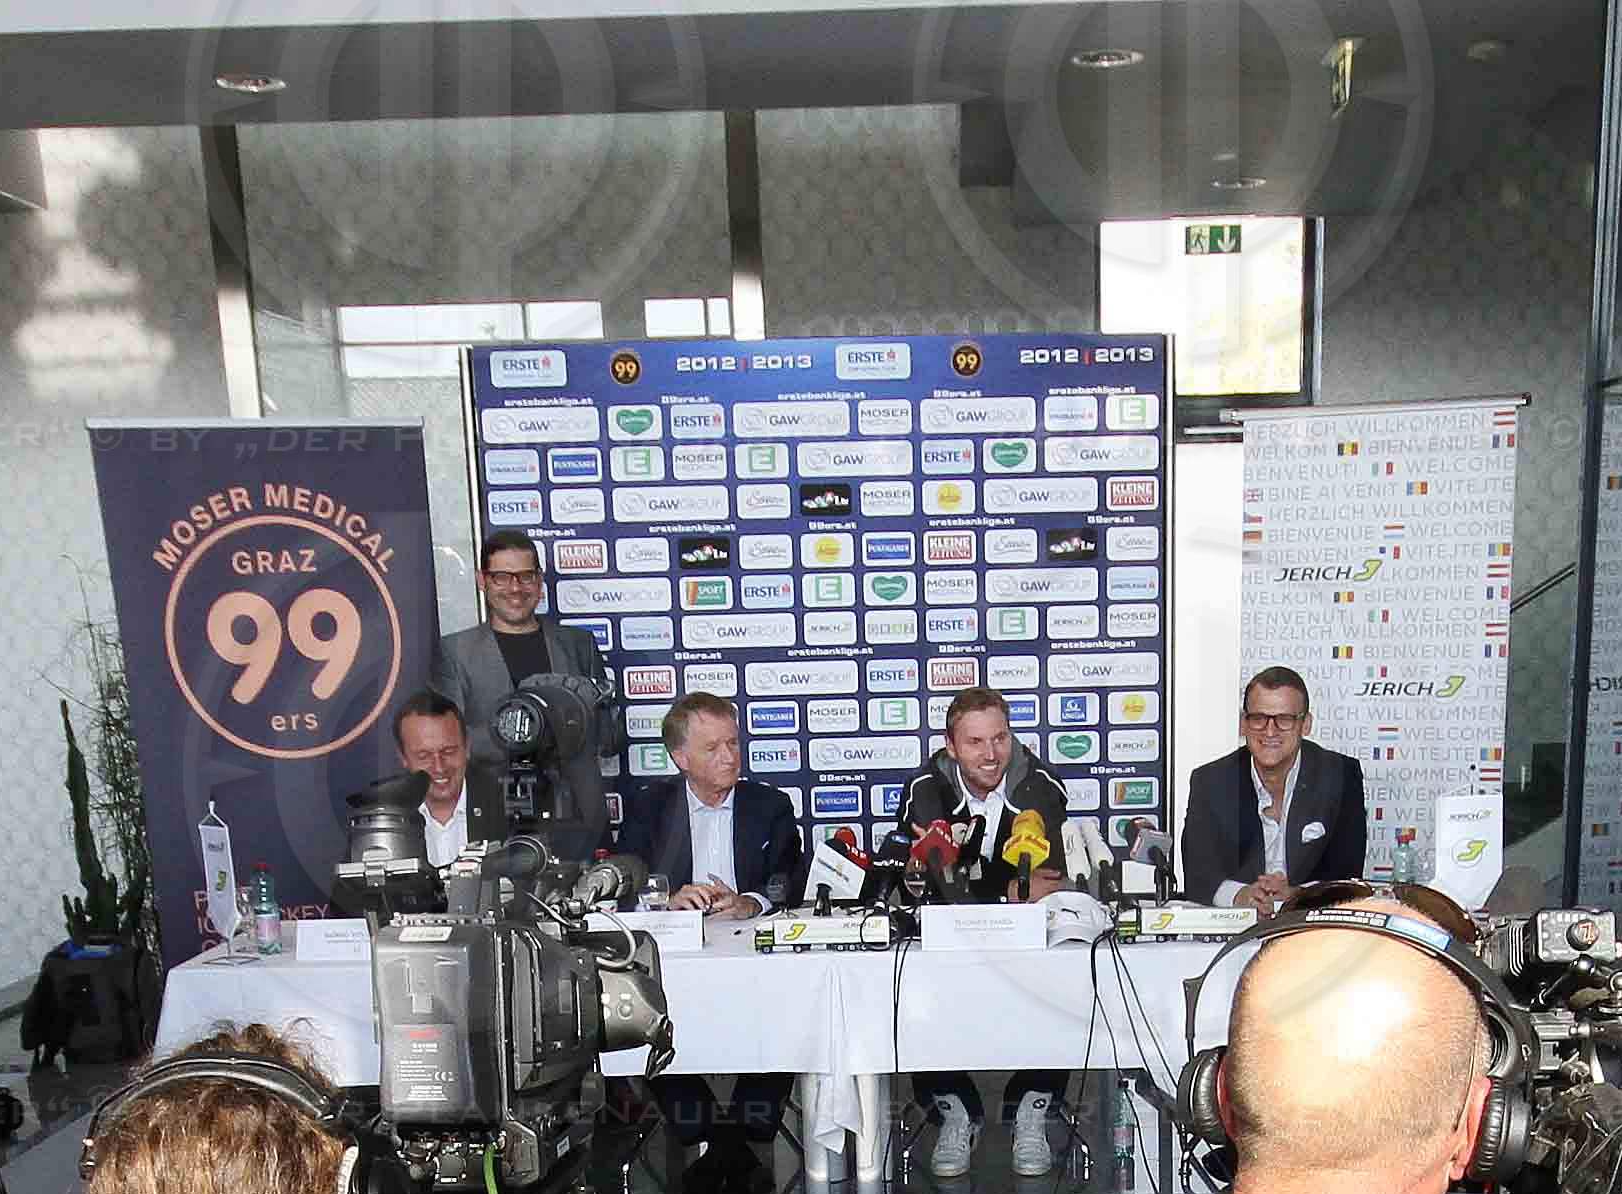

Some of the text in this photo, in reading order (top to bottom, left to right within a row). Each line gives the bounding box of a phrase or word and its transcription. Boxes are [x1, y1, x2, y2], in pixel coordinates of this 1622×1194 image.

[676, 355, 813, 372] 2012 2013
[848, 351, 886, 363] ERSTE
[1020, 347, 1154, 364] 2012 2013
[502, 358, 539, 371] ERSTE
[674, 415, 711, 427] ERSTE
[1244, 413, 1484, 441] HERZLICH WILLKOMMEN
[1243, 434, 1483, 460] WELKOM BIENVENUE
[924, 451, 962, 463] ERSTE
[1243, 456, 1515, 482] BENVENUTI WELCOME
[1111, 482, 1153, 495] KLEINE
[1435, 476, 1515, 495] VITEJTE
[491, 502, 529, 513] ERSTE
[1111, 495, 1154, 505] ZEITUNG
[1269, 501, 1513, 522] HERZLICH WILLKOMMEN
[153, 482, 396, 574] MOSER MEDICAL
[1267, 519, 1513, 543] BIENVENUE WELCOME
[929, 536, 970, 549] KLEINE
[559, 544, 601, 558] KLEINE
[929, 549, 972, 560] ZEITUNG
[1406, 544, 1482, 560] VITEJTE
[232, 549, 317, 574] GRAZ
[559, 558, 603, 569] ZEITUNG
[1274, 565, 1352, 582] JERICH
[744, 586, 781, 598] ERSTE
[1242, 585, 1475, 605] WELKOM BIENVENUE
[1242, 606, 1510, 626] BENVENUTI WELCOME
[929, 620, 965, 631] ERSTE
[1242, 624, 1478, 640] HERZLICH WILLKOMMEN
[207, 587, 361, 705] 99
[1242, 642, 1473, 661] WELKOM BIENVENUE
[629, 671, 670, 683] KLEINE
[869, 670, 905, 681] ERSTE
[933, 664, 973, 675] KLEINE
[629, 683, 671, 694] ZEITUNG
[932, 675, 975, 686] ZEITUNG
[1355, 681, 1434, 697] JERICH
[1366, 704, 1506, 721] WILLKOMMEN
[270, 713, 318, 731] ers
[1403, 726, 1506, 742] WELCOME
[752, 751, 787, 762] ERSTE
[1401, 746, 1474, 761] VITEJTE
